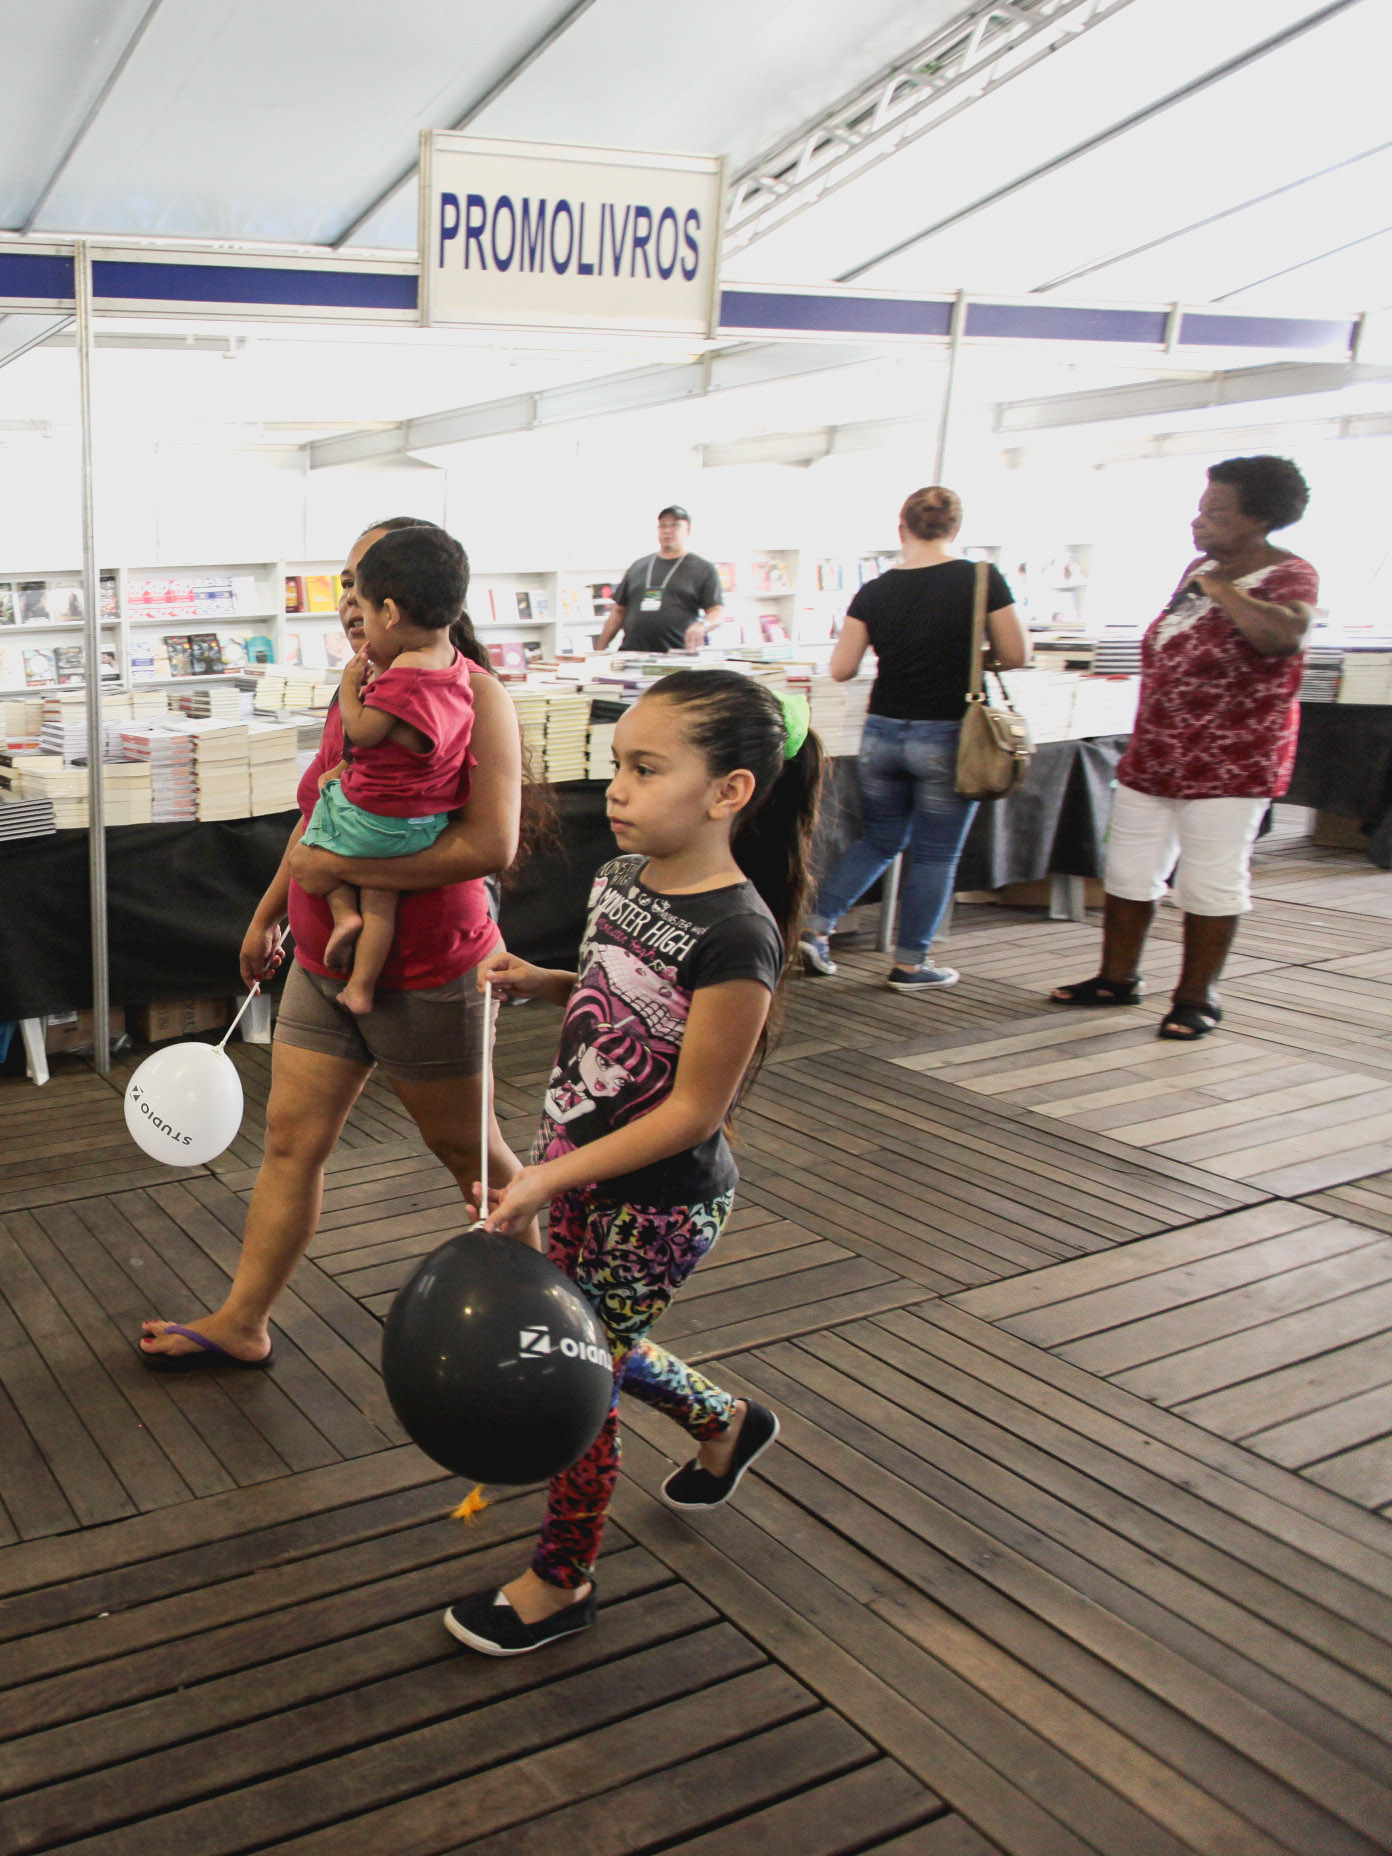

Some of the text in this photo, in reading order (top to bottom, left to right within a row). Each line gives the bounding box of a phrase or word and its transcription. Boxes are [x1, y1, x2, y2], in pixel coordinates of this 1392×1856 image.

[439, 192, 701, 282] PROMOLIVROS
[599, 887, 651, 937] MONSTER
[641, 920, 698, 962] HIGH
[140, 1102, 193, 1146] STUDIO
